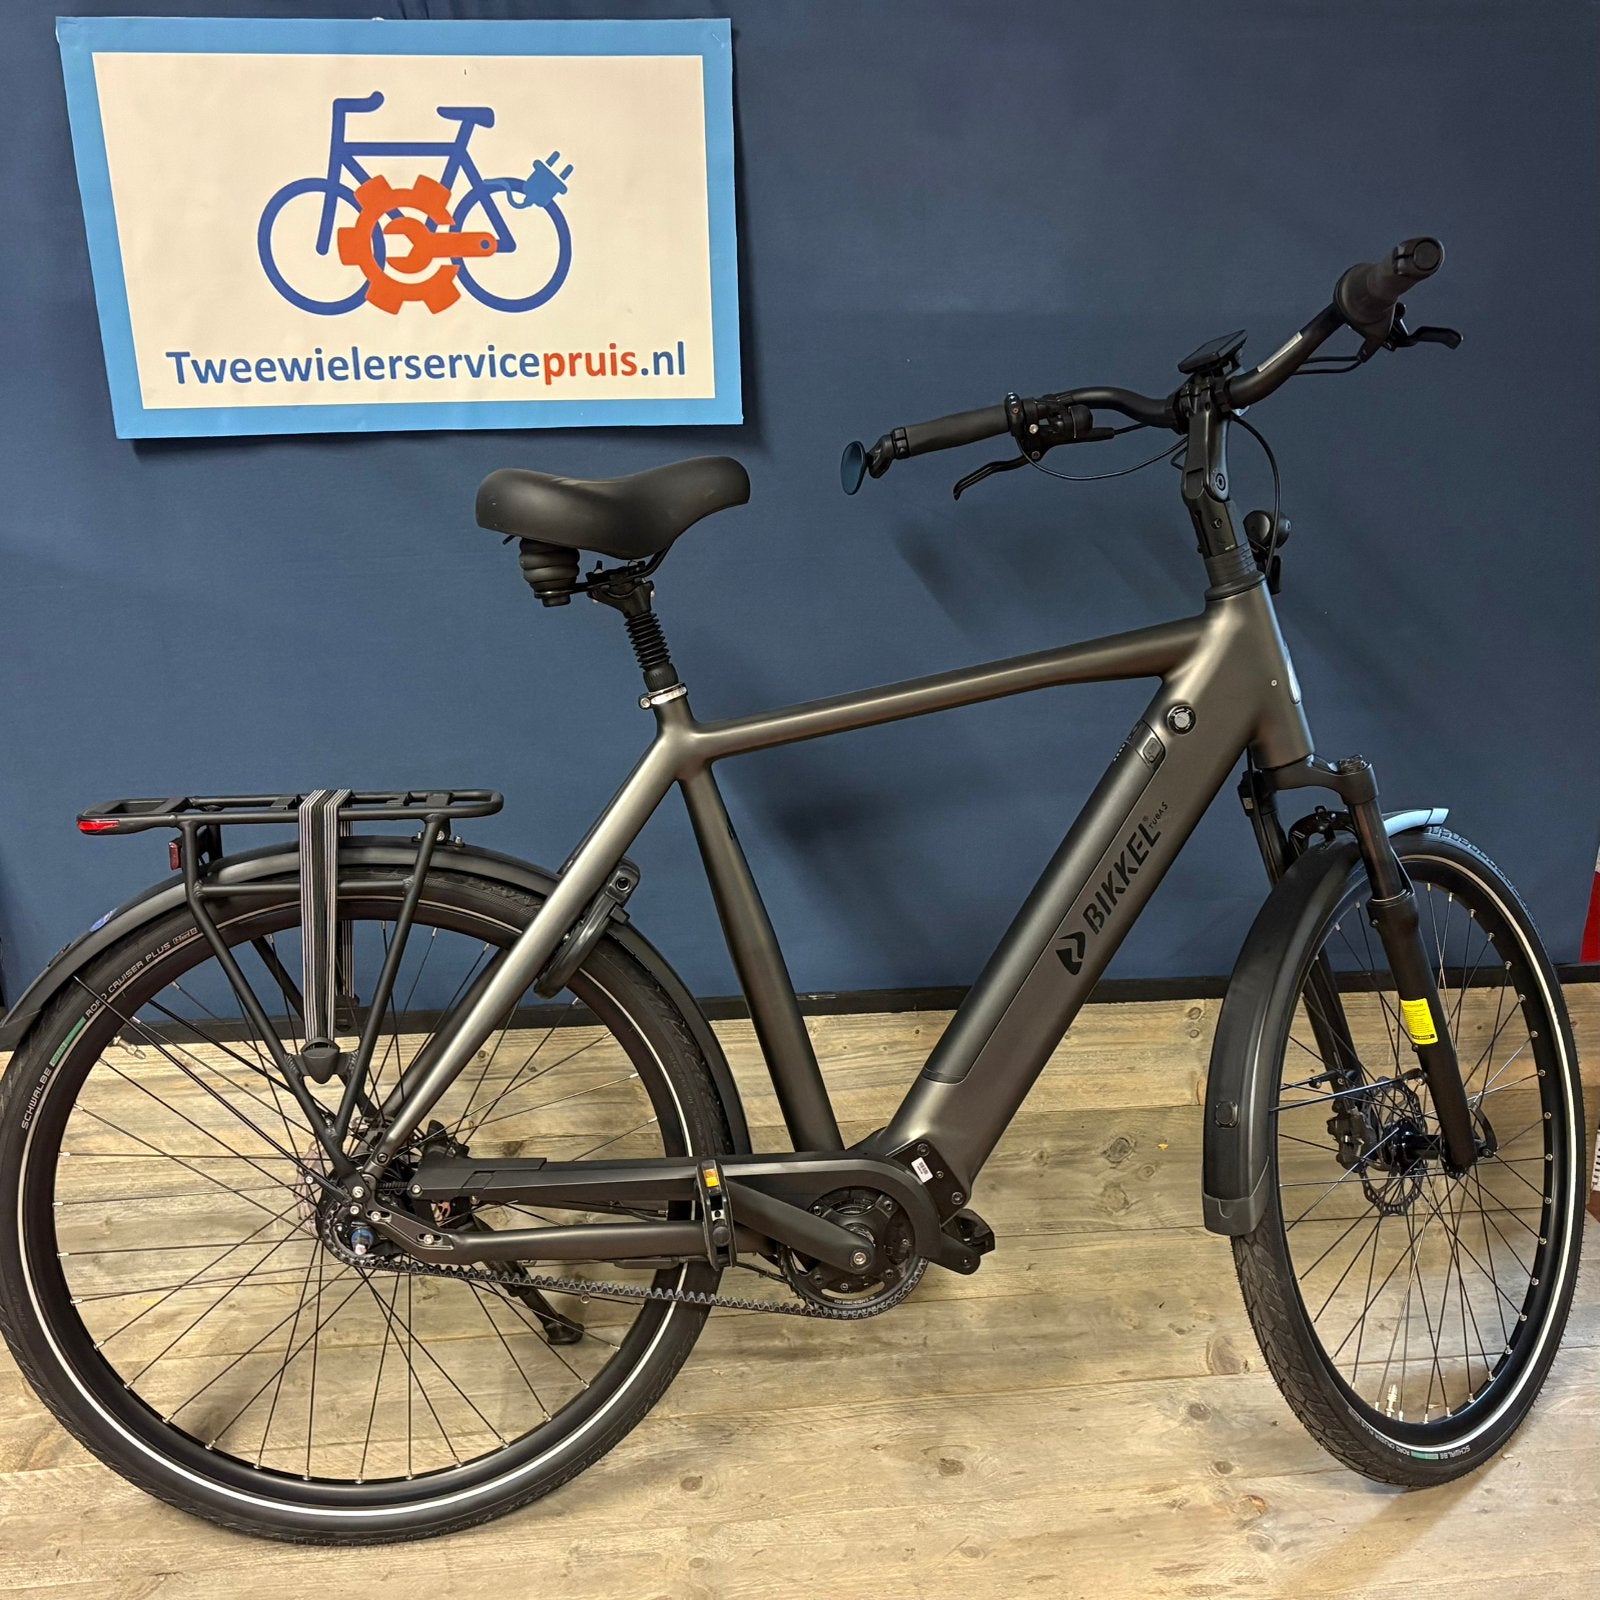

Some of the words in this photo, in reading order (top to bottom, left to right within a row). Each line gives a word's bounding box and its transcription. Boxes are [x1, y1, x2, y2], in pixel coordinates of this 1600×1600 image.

[165, 341, 686, 385] Tweewielerservicepruis.nl
[1082, 823, 1161, 934] BIKKEL
[21, 1067, 52, 1130] SCHWALBE
[108, 961, 144, 993] CRUISER
[145, 941, 171, 962] PLUS
